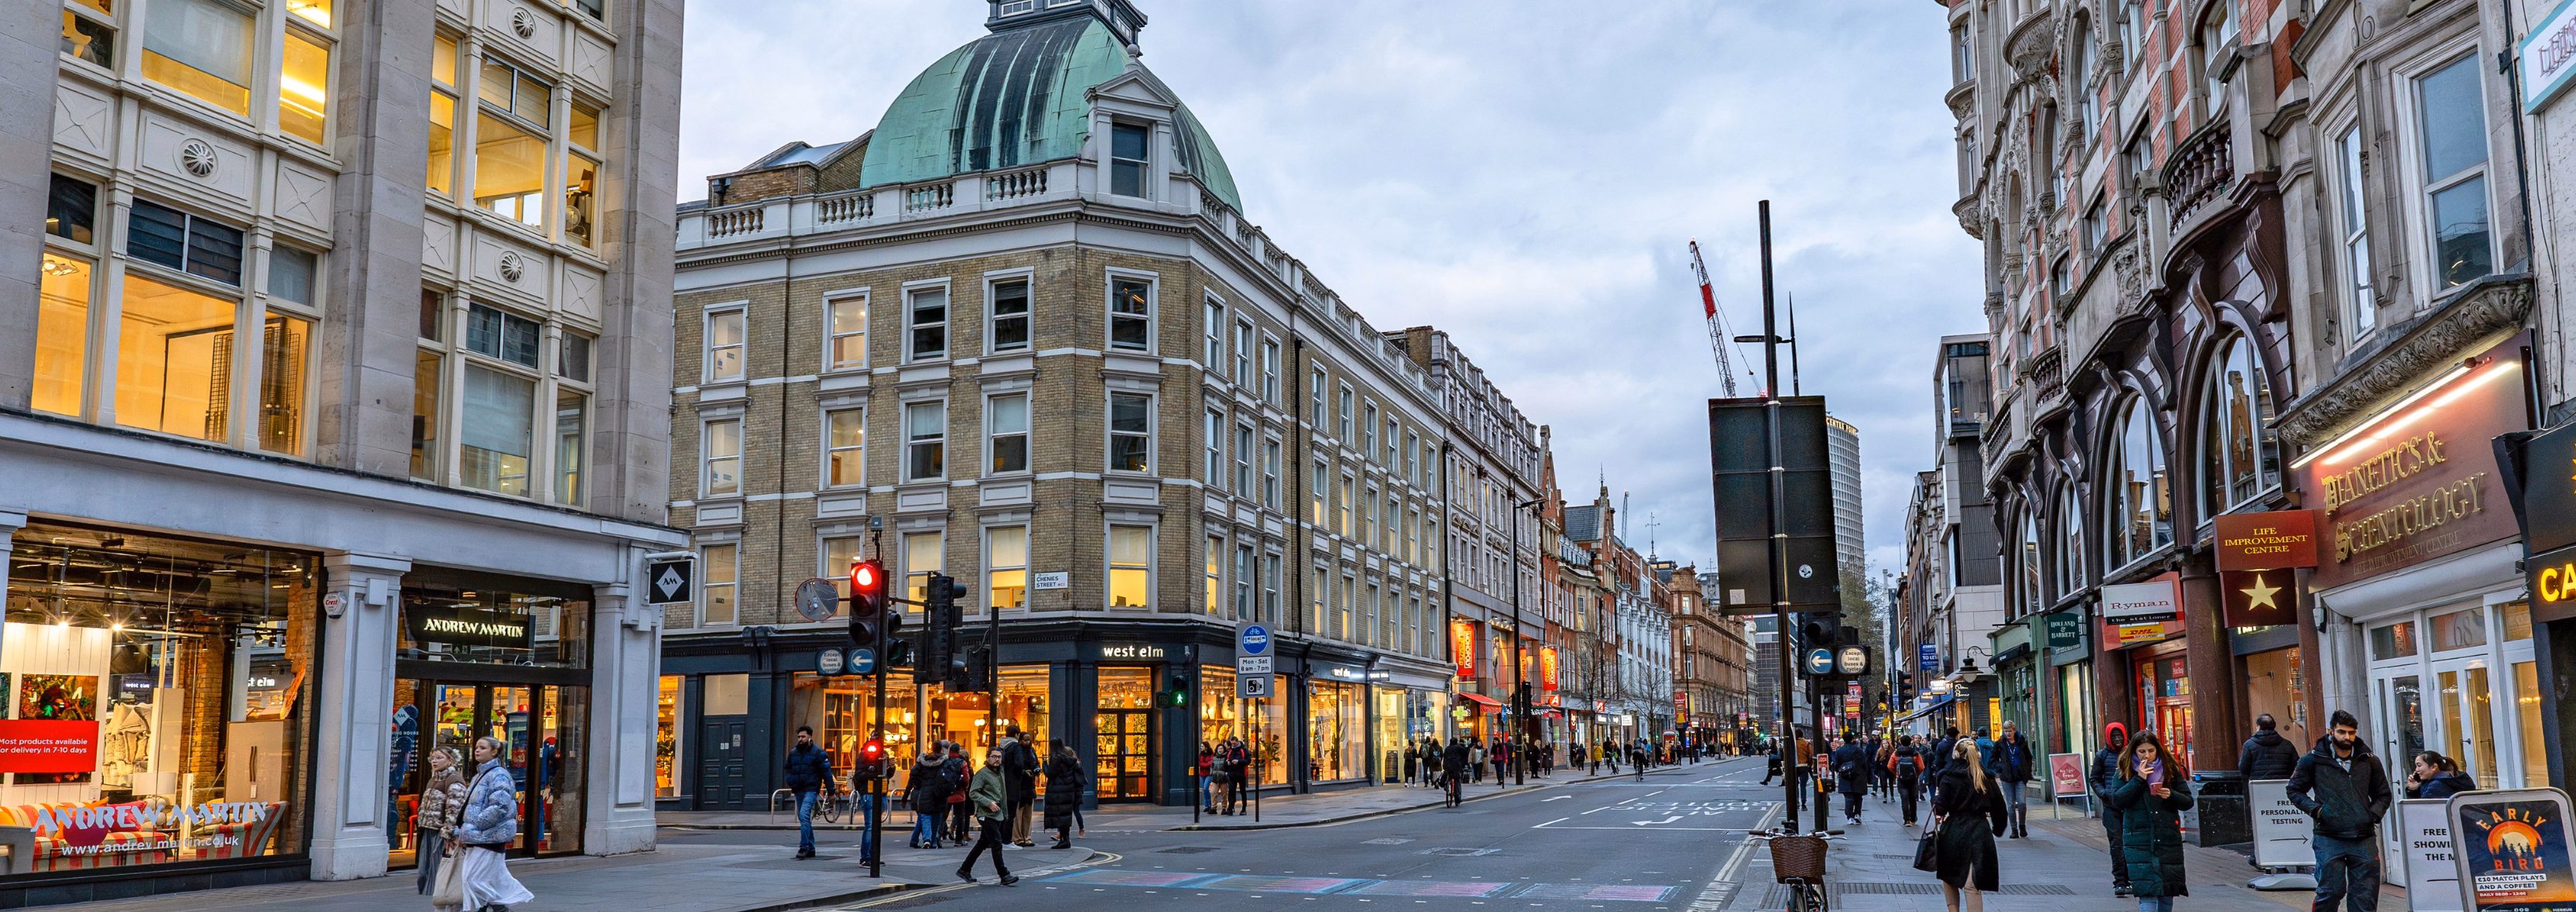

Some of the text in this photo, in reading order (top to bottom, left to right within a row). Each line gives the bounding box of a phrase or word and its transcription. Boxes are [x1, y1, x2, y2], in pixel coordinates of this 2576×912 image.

[2321, 431, 2445, 518] DIANETICS &
[2335, 471, 2485, 564] SCIENTOLOGY
[2225, 535, 2307, 546] IMPROVEMENT
[2245, 545, 2289, 554] CENTRE
[2111, 600, 2169, 609] Ryman
[423, 619, 524, 638] ANDREW MARTIN
[2454, 613, 2472, 647] 68
[1104, 645, 1163, 657] west elm
[30, 801, 269, 832] ANDREW MARTIN
[2475, 808, 2547, 831] EARLY
[2494, 857, 2544, 870] BIRD
